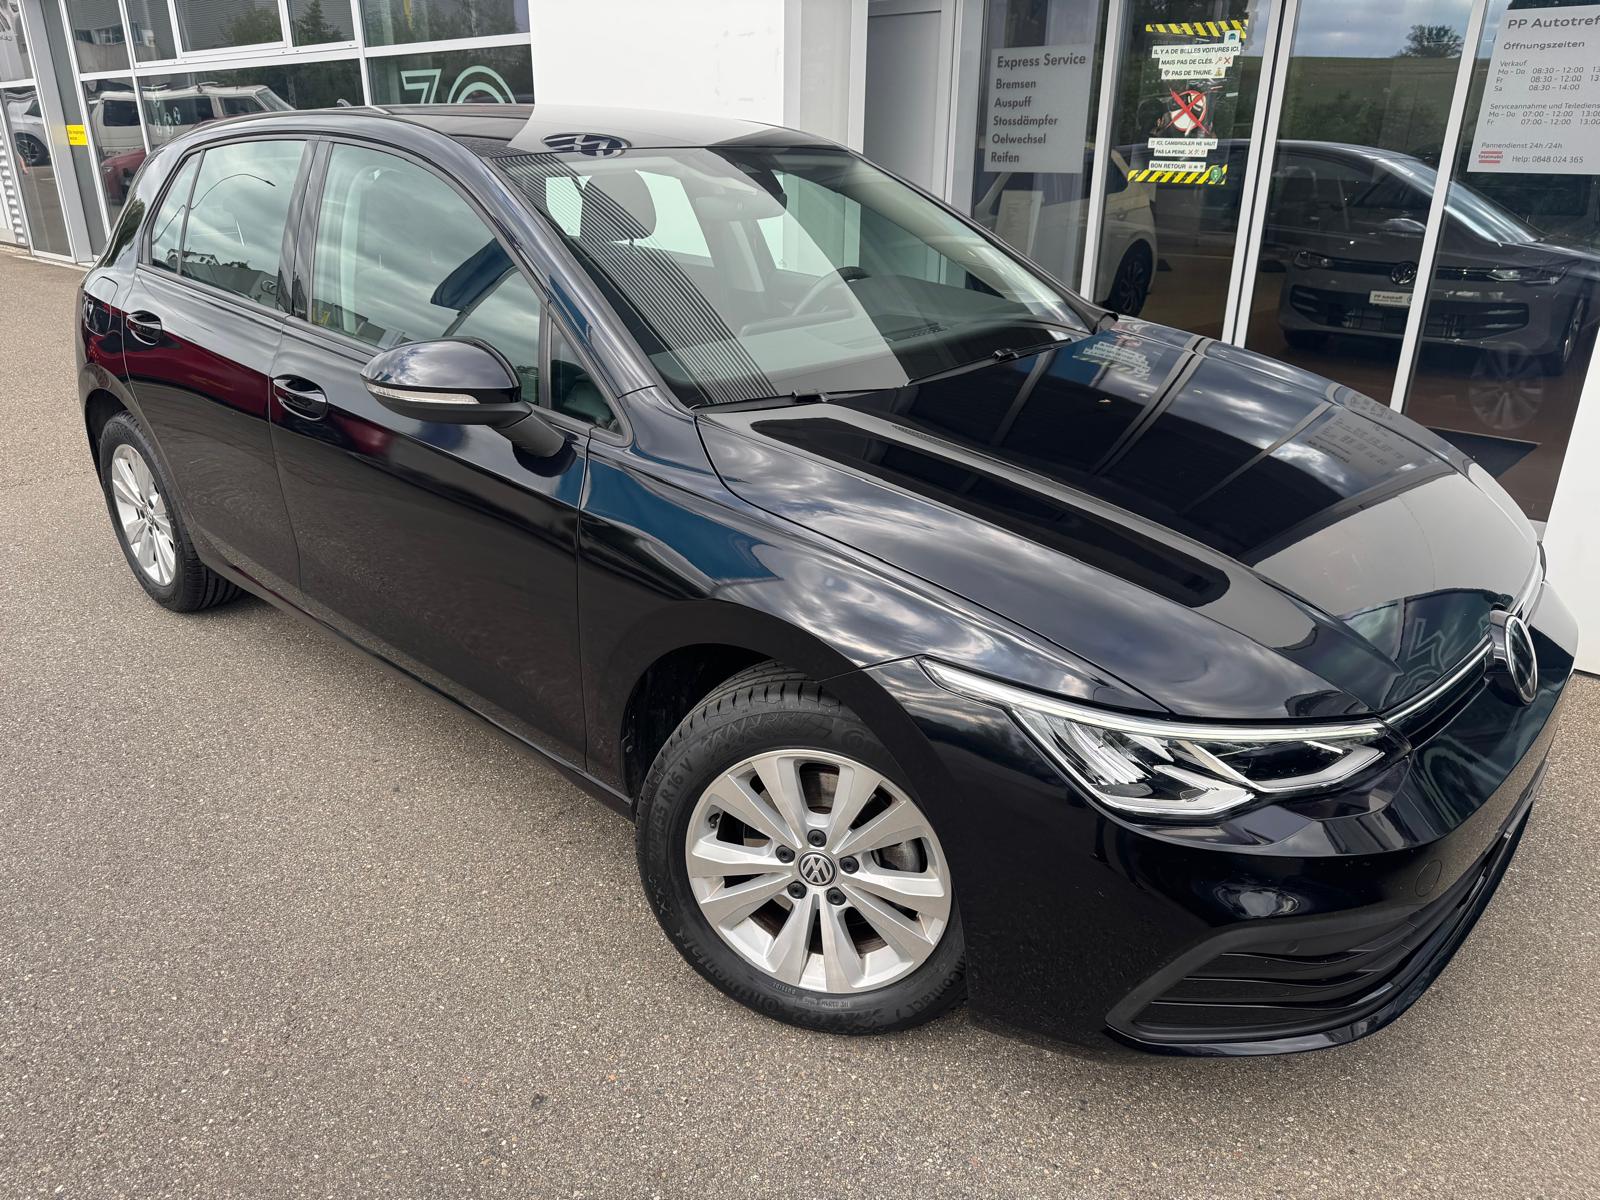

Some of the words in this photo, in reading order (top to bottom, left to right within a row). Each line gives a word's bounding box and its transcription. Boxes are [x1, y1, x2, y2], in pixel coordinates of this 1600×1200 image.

[1507, 18, 1528, 29] PP
[1503, 40, 1585, 51] Öffnungszeiten
[997, 55, 1040, 70] Express
[1043, 52, 1086, 66] Service
[996, 78, 1036, 89] Bremsen
[994, 96, 1032, 109] Auspuff
[993, 114, 1058, 128] Stossdämpfer
[992, 133, 1046, 144] Oelwechsel
[990, 151, 1020, 163] Reifen
